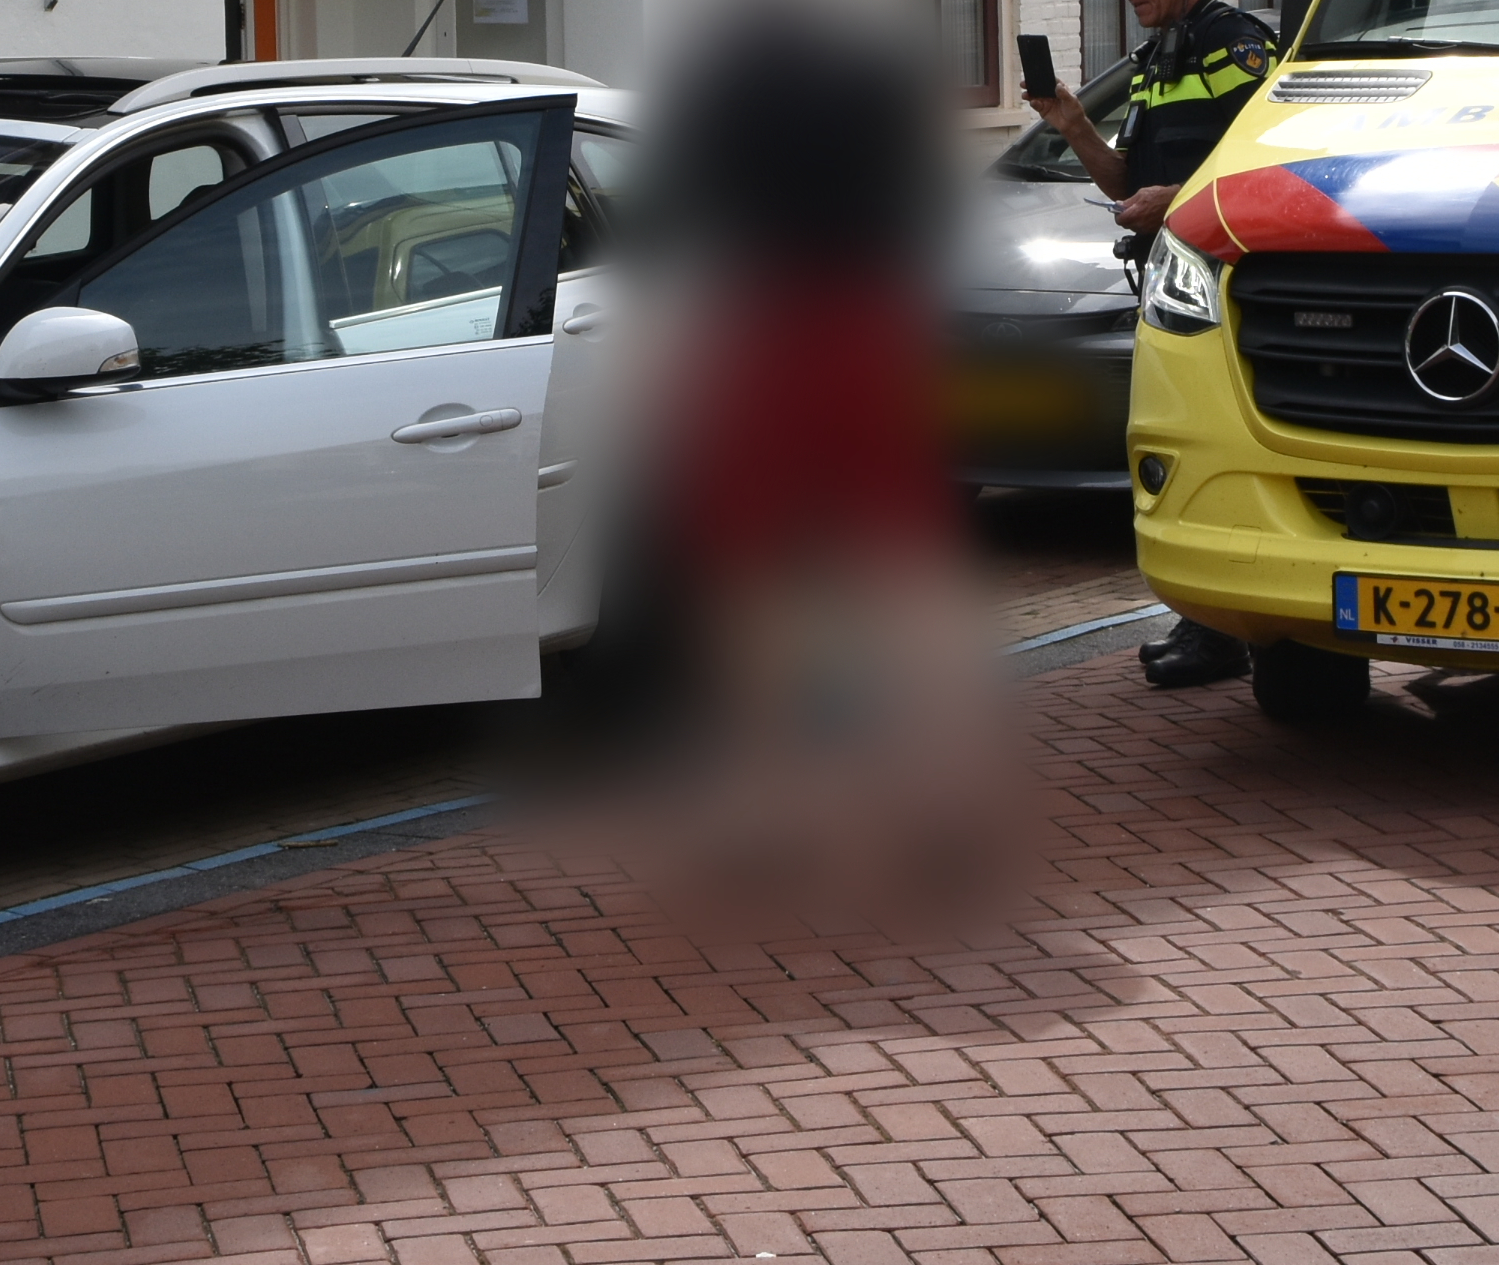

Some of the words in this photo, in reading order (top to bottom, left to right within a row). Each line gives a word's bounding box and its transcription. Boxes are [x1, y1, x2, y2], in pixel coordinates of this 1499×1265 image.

[1233, 42, 1262, 53] POLITIE
[1339, 608, 1356, 621] NL
[1405, 637, 1438, 646] VISSER
